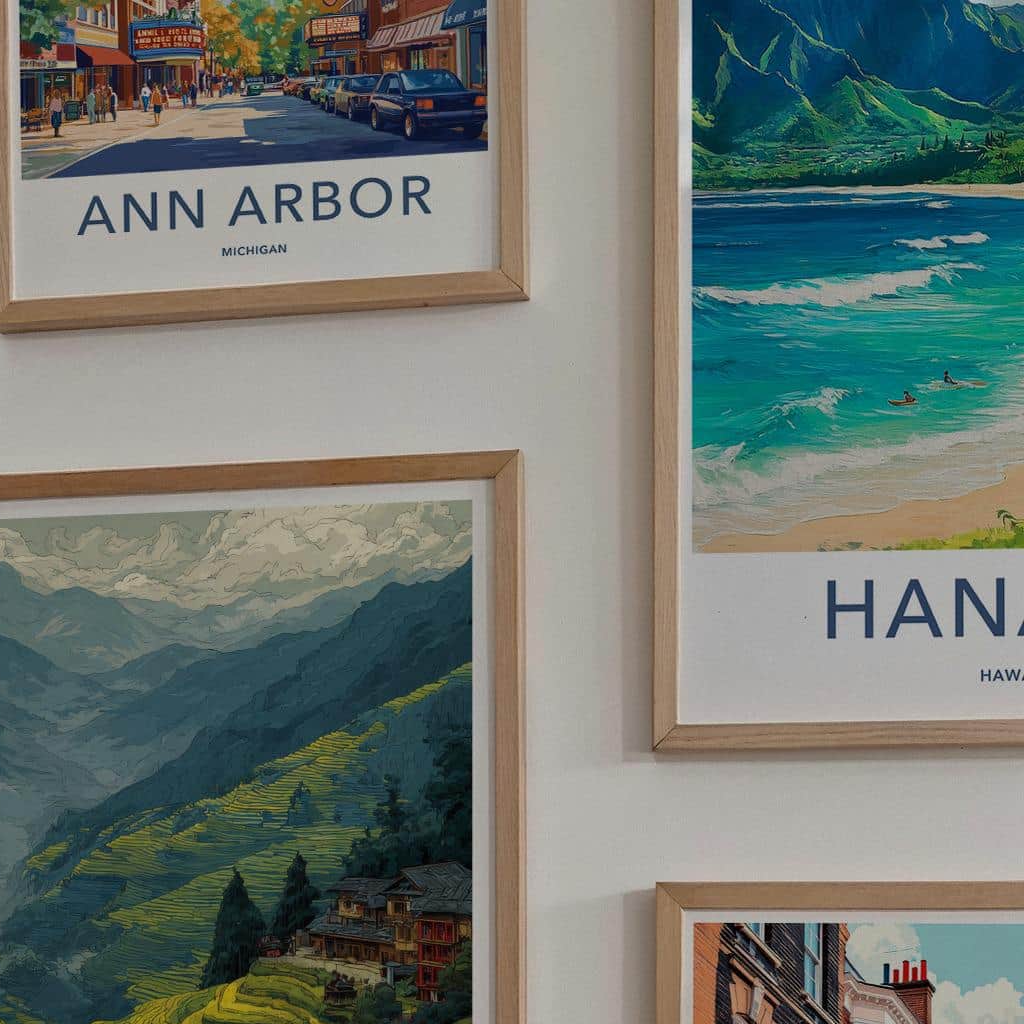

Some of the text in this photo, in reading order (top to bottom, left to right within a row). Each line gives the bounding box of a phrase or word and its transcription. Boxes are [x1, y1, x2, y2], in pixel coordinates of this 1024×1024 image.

[77, 176, 433, 236] ANN ARBOR
[221, 244, 288, 257] MICHIGAN
[826, 577, 1024, 640] HAN
